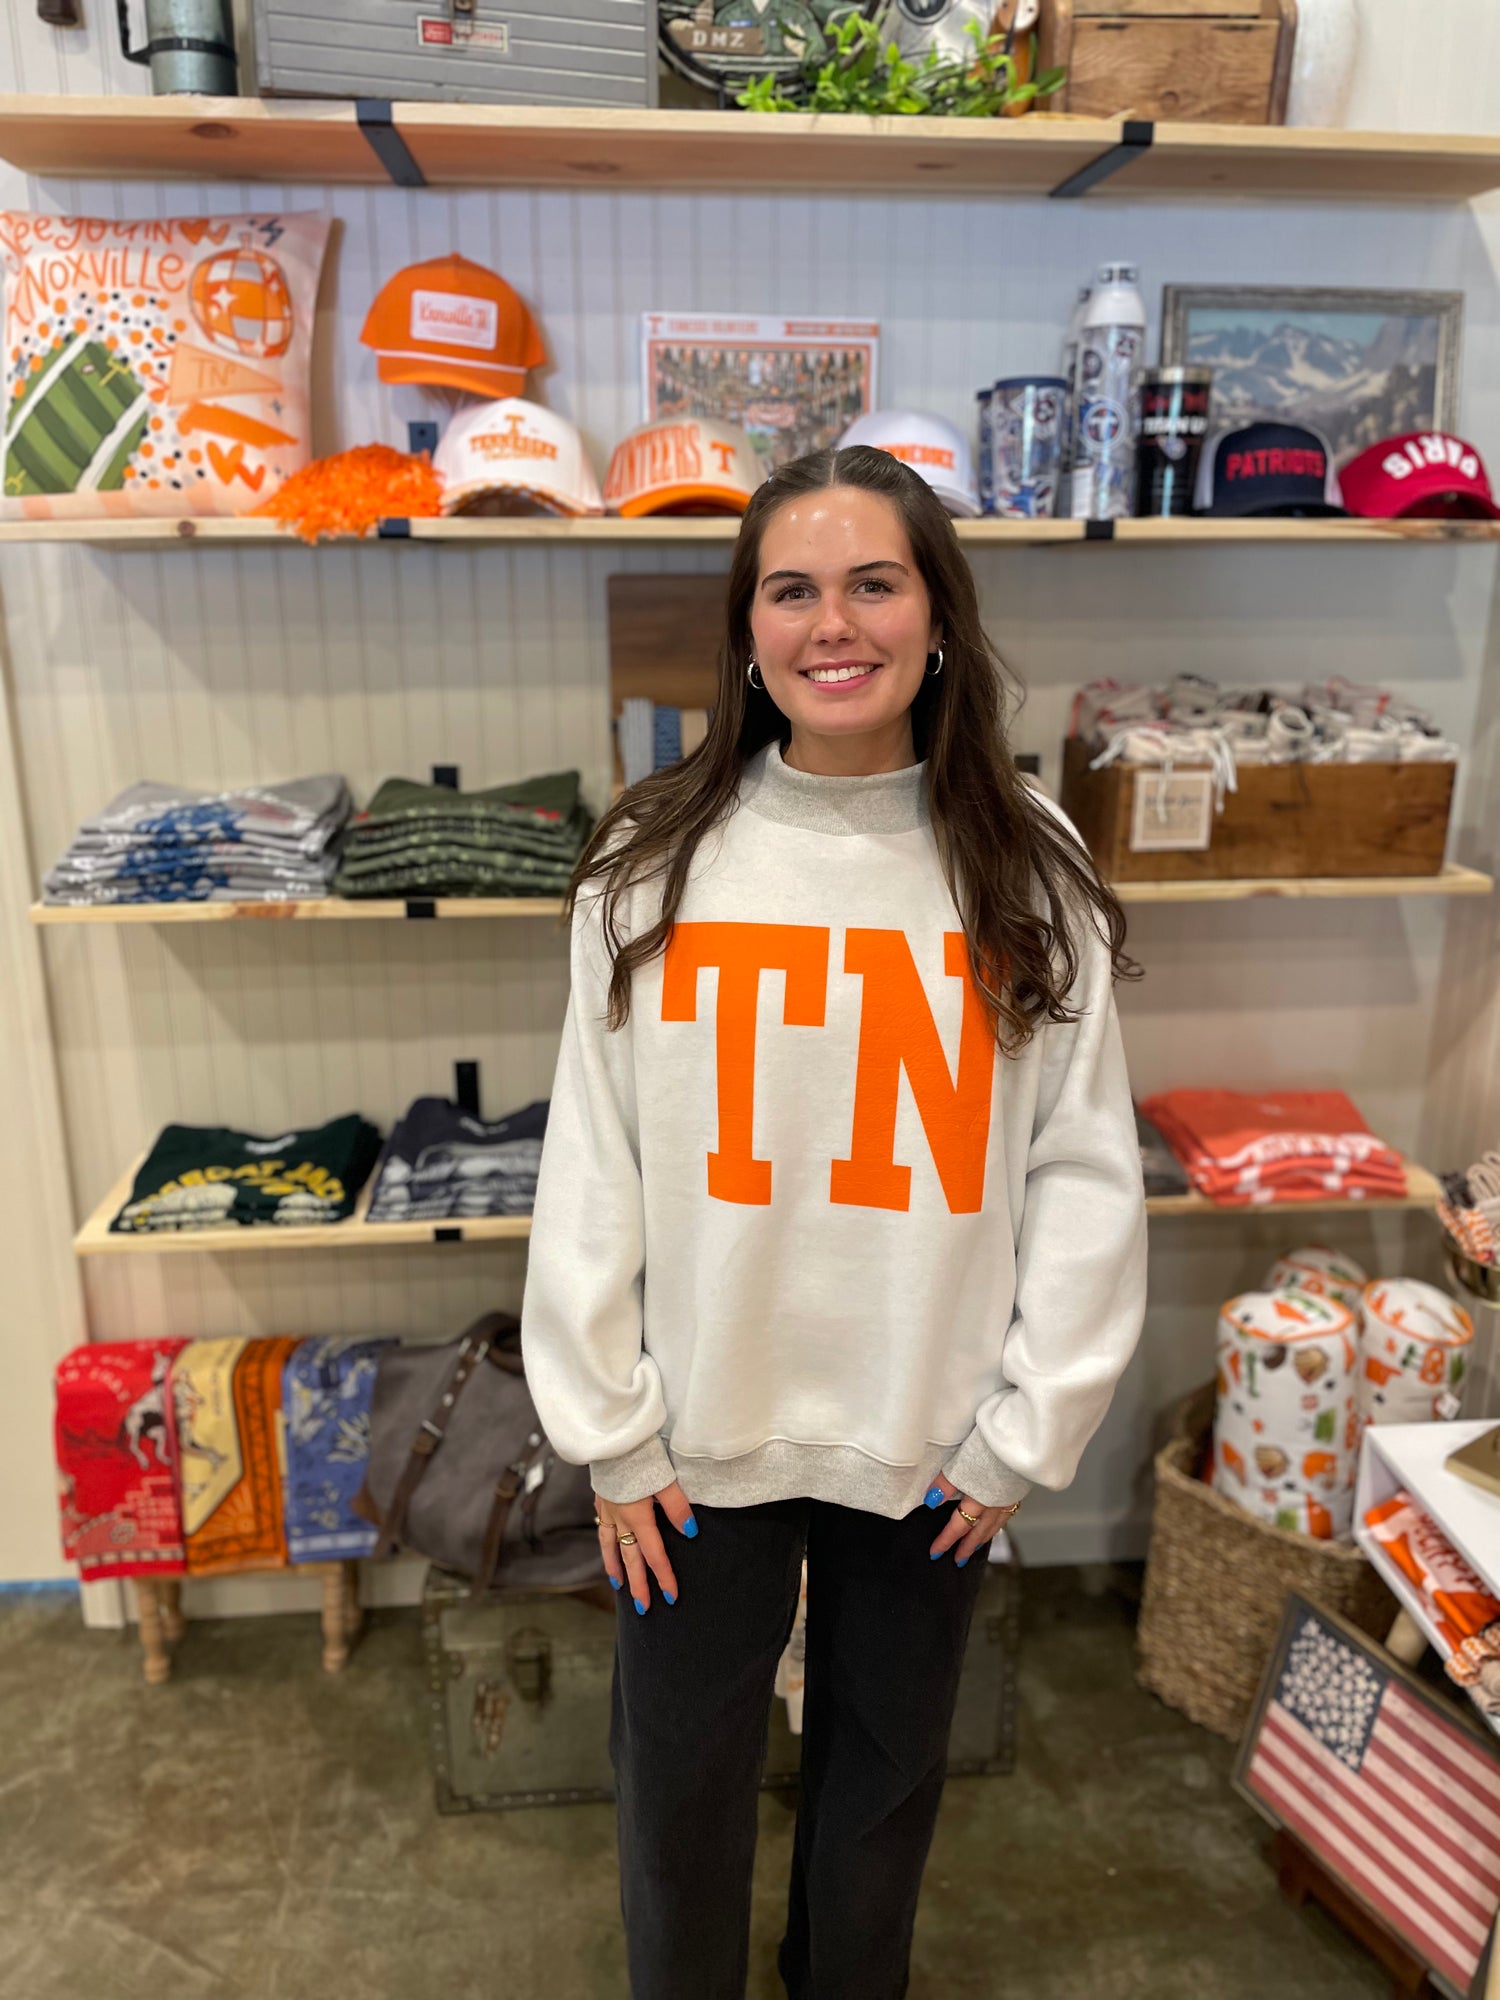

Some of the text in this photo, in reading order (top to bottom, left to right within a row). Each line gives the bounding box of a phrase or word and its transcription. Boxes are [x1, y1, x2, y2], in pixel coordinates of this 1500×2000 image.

[692, 30, 744, 47] DMZ
[710, 440, 737, 473] T
[1226, 447, 1325, 481] PATRIOTS
[661, 921, 1008, 1214] TN
